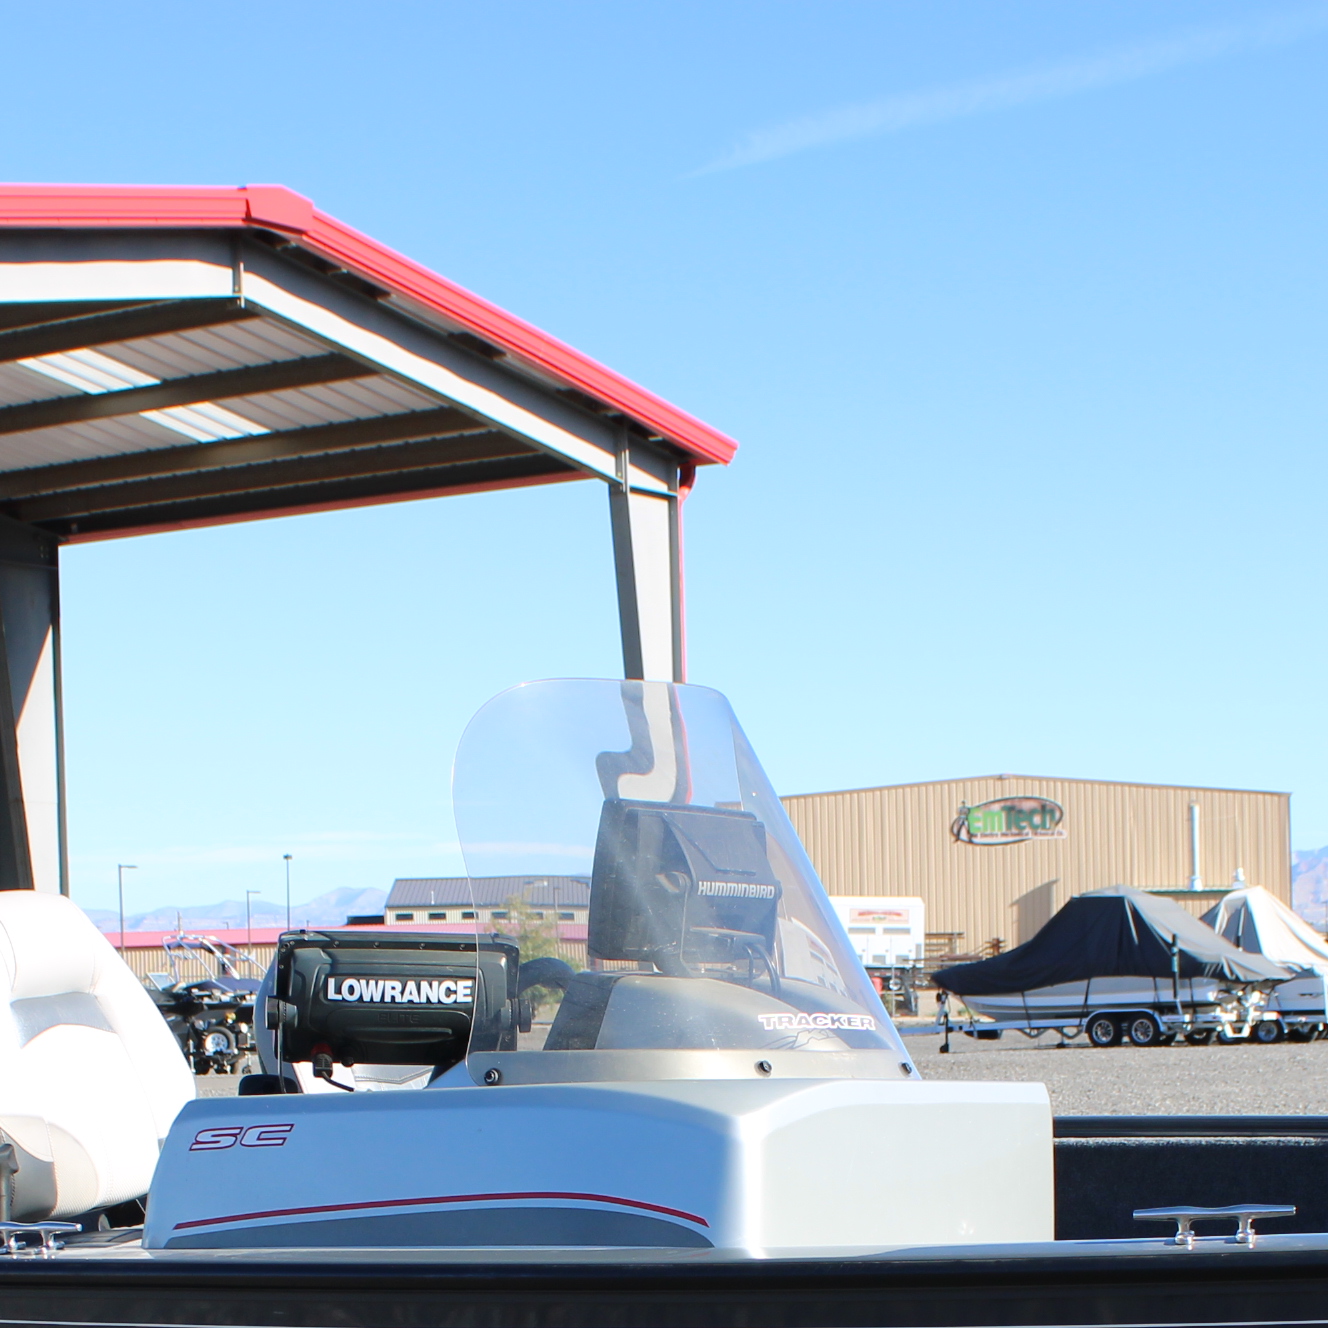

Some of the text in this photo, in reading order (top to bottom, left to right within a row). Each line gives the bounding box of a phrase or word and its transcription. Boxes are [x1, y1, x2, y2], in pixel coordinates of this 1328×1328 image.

[968, 804, 1056, 832] EmTech
[698, 881, 775, 899] HUMMINBIRD
[327, 977, 473, 1004] LOWRANCE
[378, 1012, 421, 1024] ELITE
[758, 1013, 876, 1031] TRACKER
[188, 1123, 295, 1152] SC
